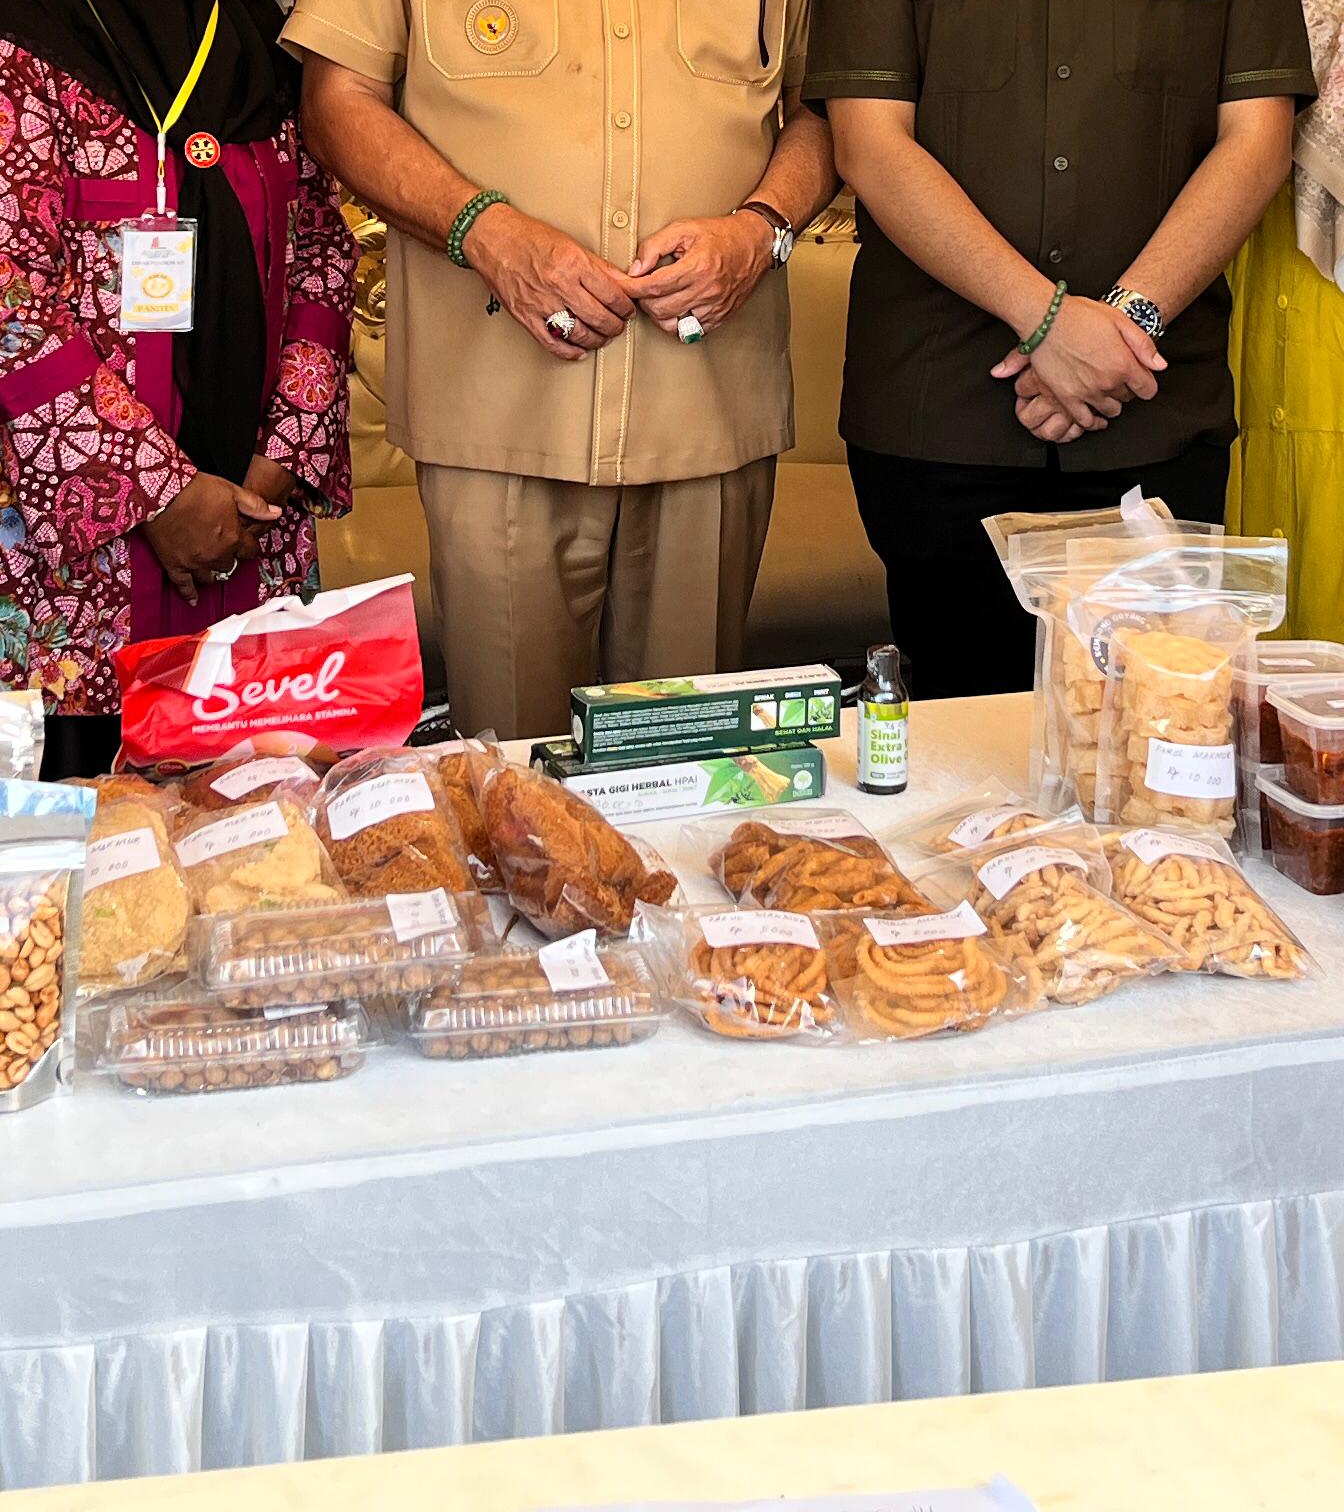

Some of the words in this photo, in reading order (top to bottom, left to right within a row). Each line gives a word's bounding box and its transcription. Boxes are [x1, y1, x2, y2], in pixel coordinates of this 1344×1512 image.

[191, 720, 249, 734] MEMBANTU
[249, 713, 313, 728] MEMELIHARA
[315, 706, 359, 721] STAMINA
[870, 741, 902, 752] Extra
[870, 754, 902, 765] Olive
[608, 784, 629, 794] GIGI
[631, 779, 673, 792] HERBAL
